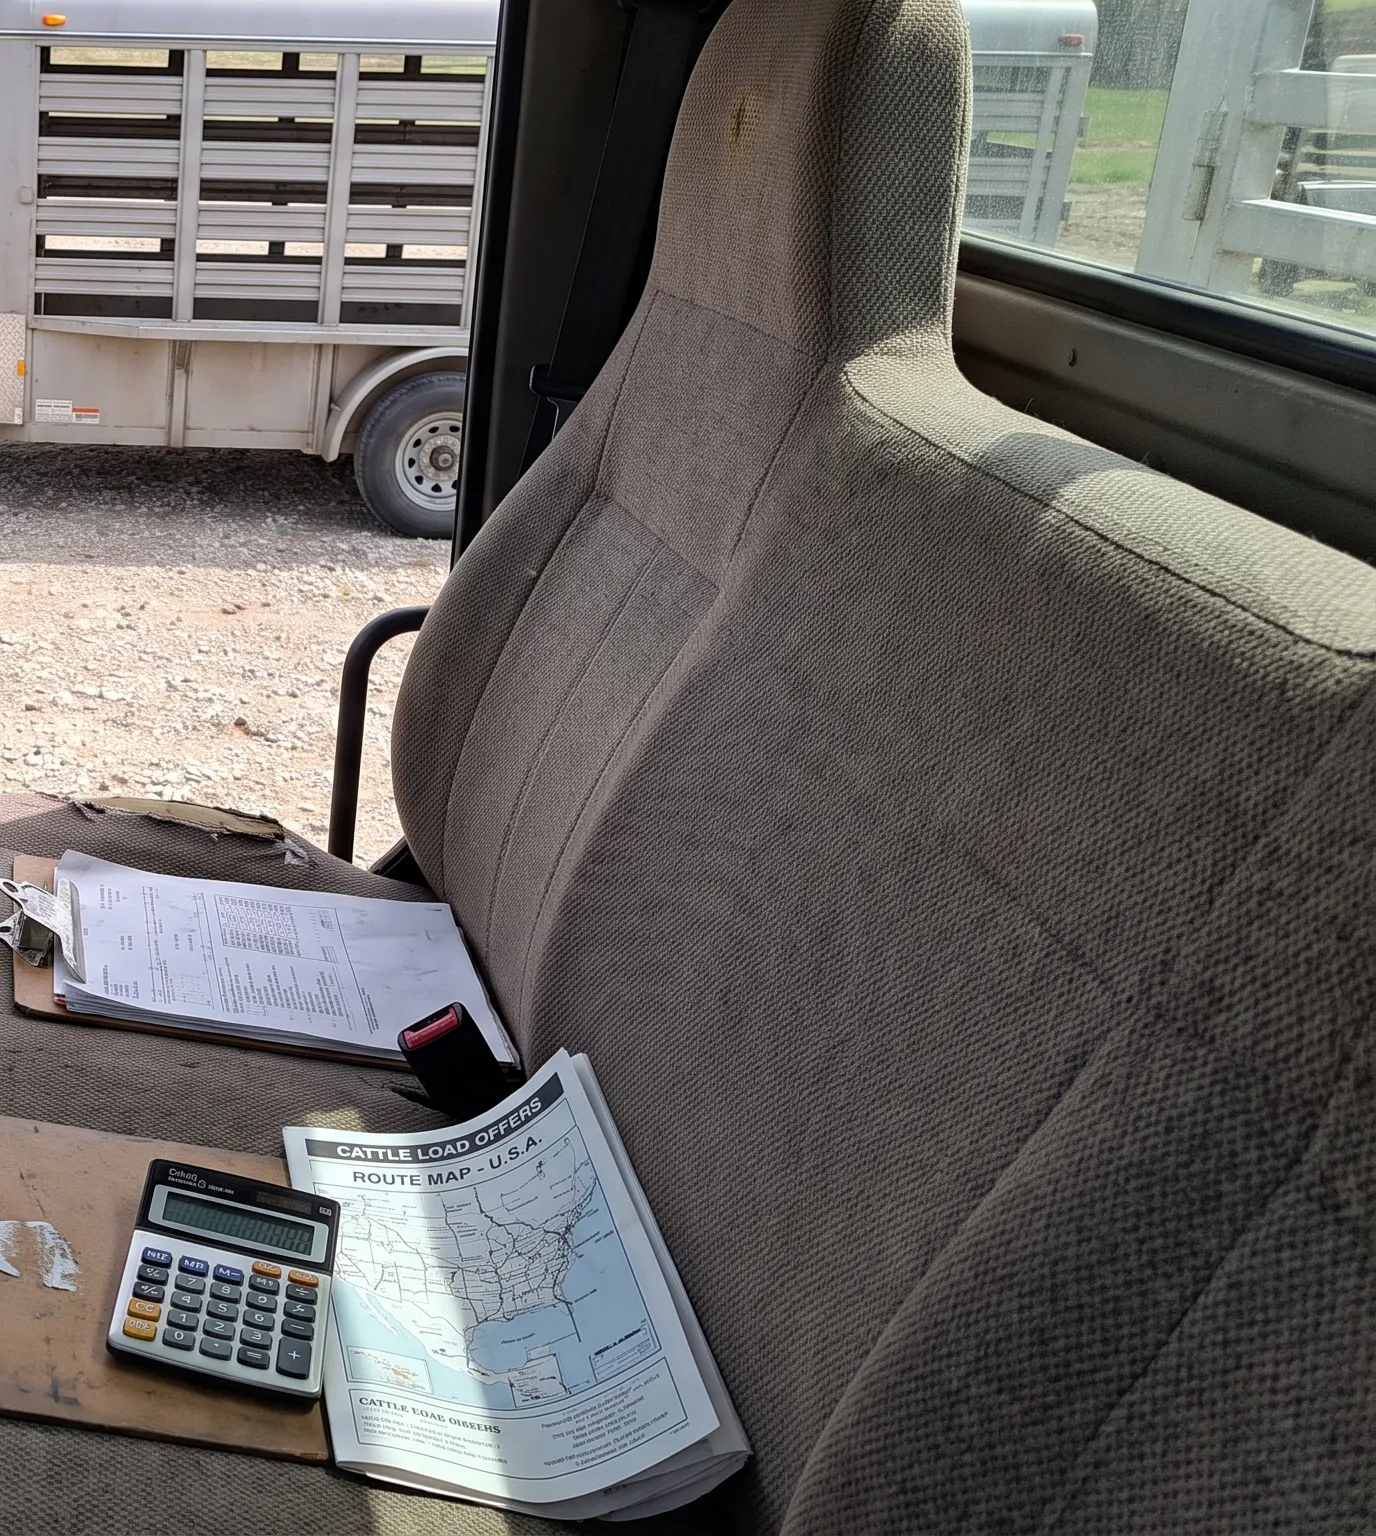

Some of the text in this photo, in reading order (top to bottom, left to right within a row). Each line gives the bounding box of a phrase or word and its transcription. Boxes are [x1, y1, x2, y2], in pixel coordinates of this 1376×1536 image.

[336, 1097, 543, 1161] CATTLE LOAD OFFERS
[352, 1171, 422, 1187] ROUTE
[426, 1166, 472, 1187] MAP
[488, 1136, 543, 1170] U.S.A.
[187, 1277, 197, 1285] 7
[221, 1285, 231, 1294] 8
[181, 1295, 191, 1304] 4
[218, 1304, 228, 1313] 5
[179, 1313, 186, 1322] 1
[254, 1313, 264, 1322] 6
[214, 1322, 225, 1331] 2
[174, 1331, 184, 1340] 0
[251, 1331, 262, 1340] 3
[359, 1397, 410, 1413] CATTLE
